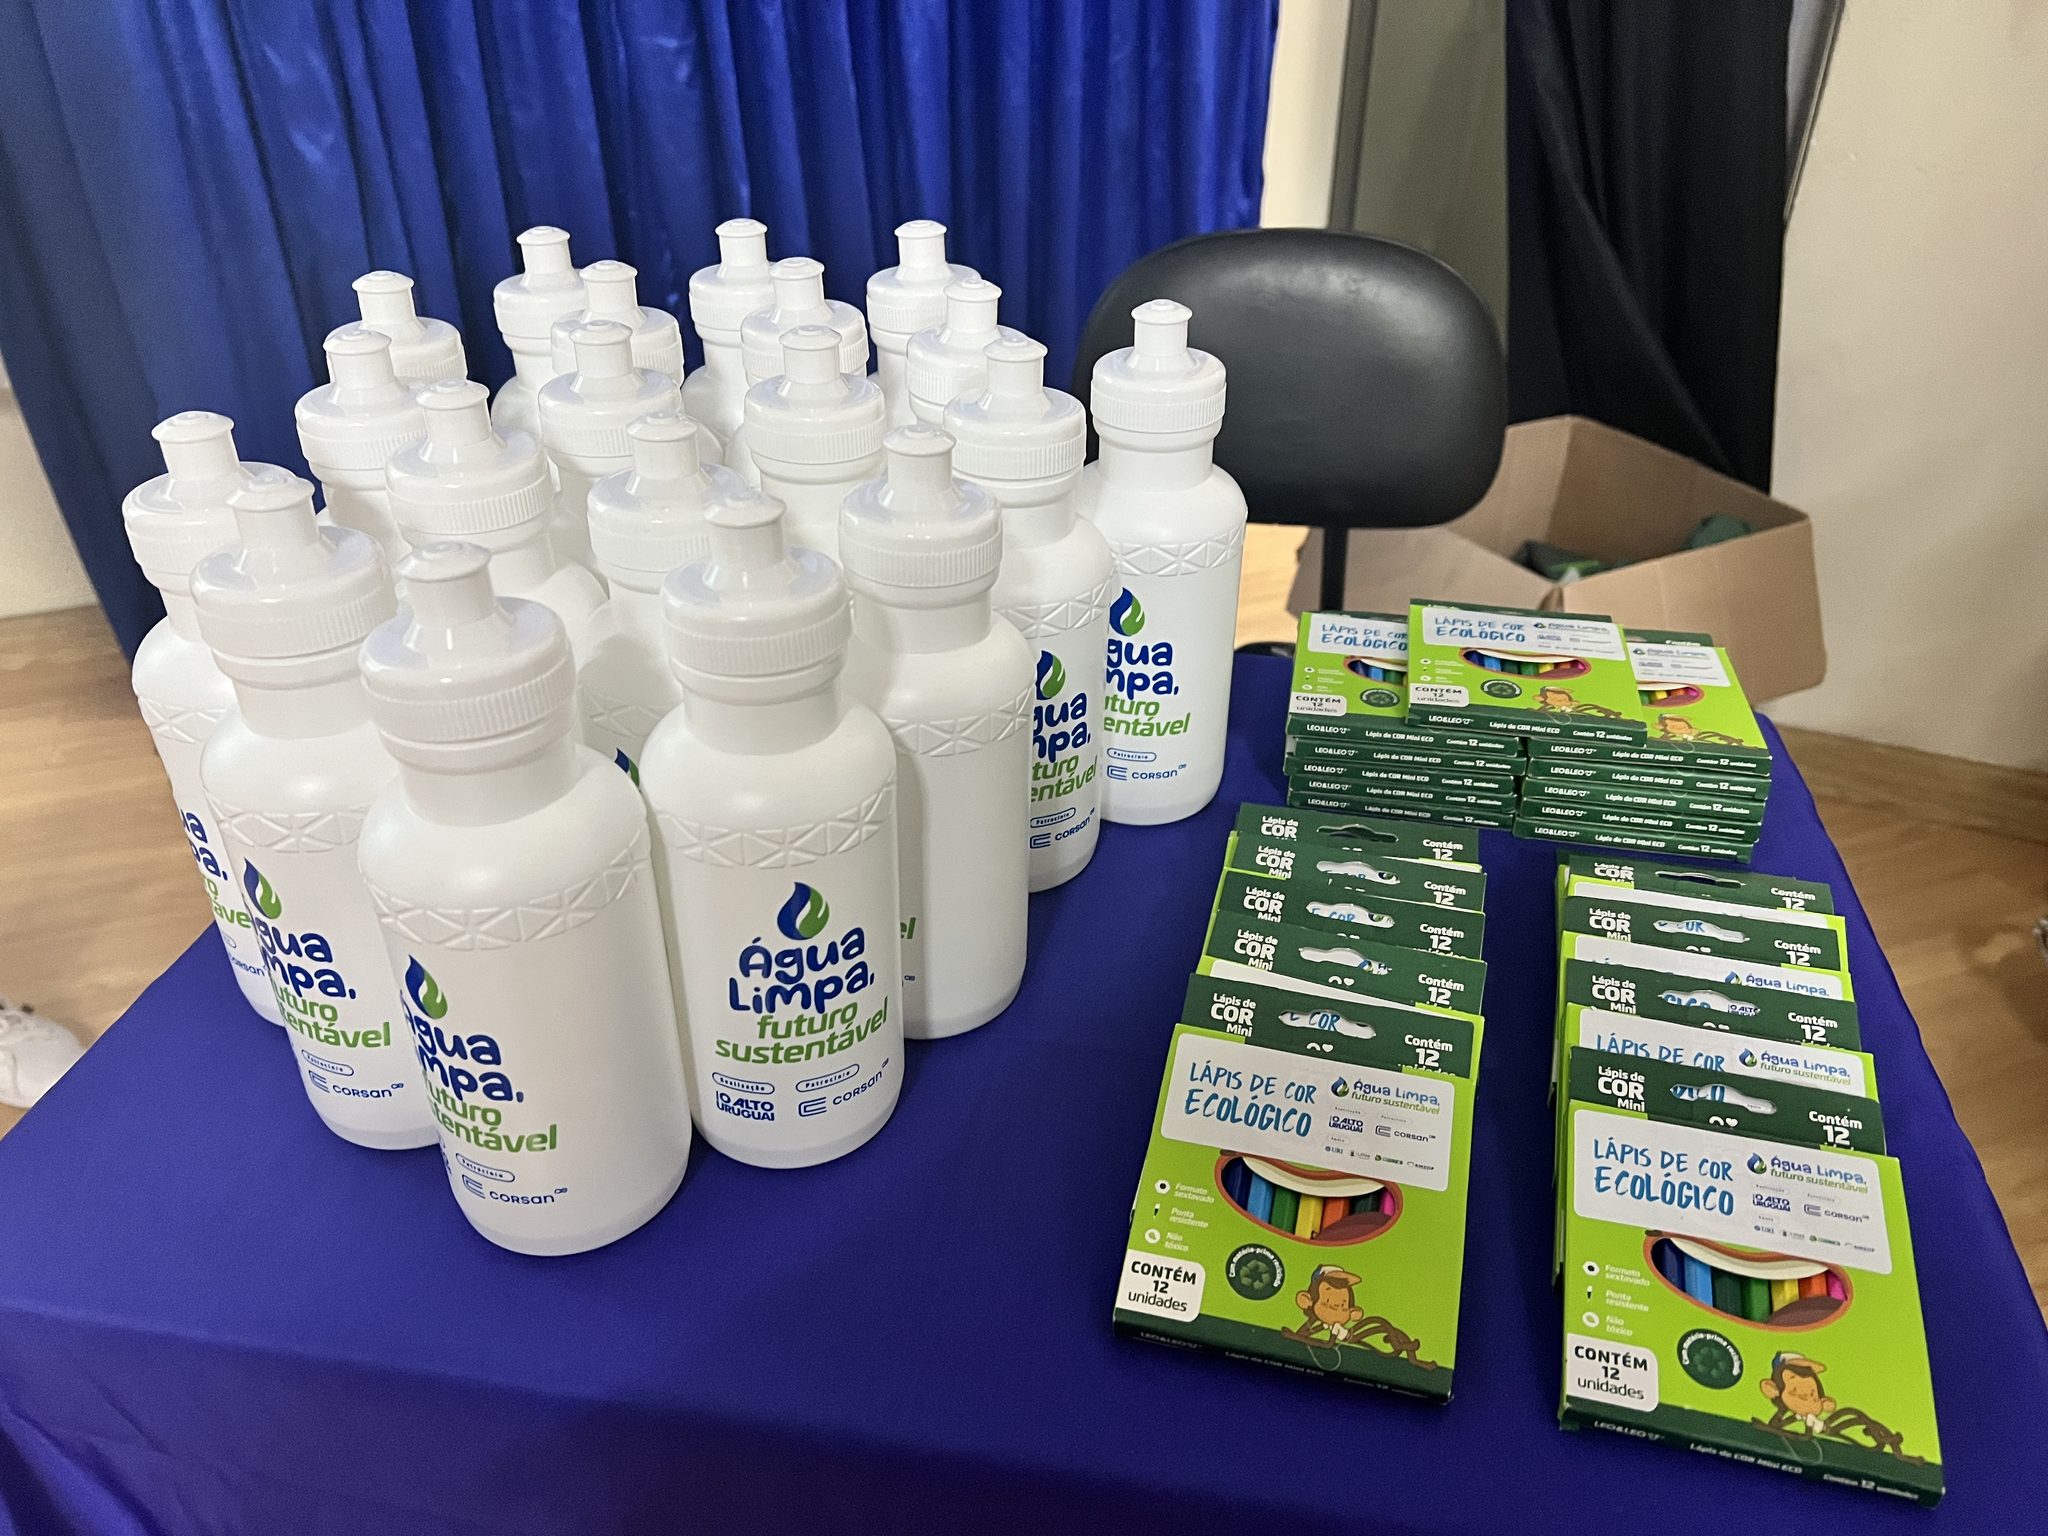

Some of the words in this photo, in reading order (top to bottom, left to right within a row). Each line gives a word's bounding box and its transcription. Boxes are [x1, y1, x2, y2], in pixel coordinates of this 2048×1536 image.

[1363, 628, 1381, 637] DE
[1478, 620, 1496, 629] DE
[1502, 622, 1525, 631] COR
[1321, 633, 1408, 651] ECOLÓGICO
[1436, 626, 1525, 643] ECOLÓGICO
[1107, 638, 1173, 668] gua
[1595, 731, 1606, 739] 12
[1262, 816, 1286, 826] Lápis
[1287, 819, 1299, 827] de
[1261, 823, 1297, 839] COR
[1258, 845, 1282, 856] Lápis
[1283, 850, 1296, 859] de
[1422, 839, 1463, 851] Contém
[1255, 852, 1294, 871] COR
[1432, 848, 1453, 861] 12
[1594, 867, 1634, 881] COR
[1246, 886, 1272, 898] Lápis
[1272, 891, 1286, 901] de
[1424, 881, 1466, 895] Contém
[1771, 887, 1816, 900] Contém
[1243, 895, 1283, 915] COR
[1433, 891, 1455, 906] 12
[1782, 896, 1805, 911] 12
[1589, 908, 1617, 918] Lápis
[1617, 912, 1631, 920] de
[1420, 923, 1465, 939] Contém
[1589, 915, 1630, 933] COR
[1237, 929, 1264, 942] Lápis
[1265, 936, 1279, 945] de
[1429, 935, 1452, 951] 12
[1234, 938, 1276, 960] COR
[1774, 939, 1821, 955] Contém
[739, 927, 865, 985] Água
[1786, 950, 1811, 967] 12
[1418, 974, 1465, 992] Contém
[1592, 975, 1620, 988] Lápis
[1622, 979, 1636, 990] de
[1745, 973, 1781, 988] Água
[1213, 993, 1242, 1006] Lápis
[1242, 999, 1257, 1009] de
[1428, 987, 1451, 1006] 12
[1591, 984, 1636, 1005] COR
[1210, 1003, 1254, 1026] COR
[1610, 1001, 1637, 1015] Mini
[757, 1002, 858, 1040] futuro
[1787, 1012, 1838, 1029] Contém
[715, 995, 888, 1064] sustentável
[1226, 1023, 1253, 1037] Mini
[1801, 1024, 1827, 1042] 12
[1404, 1034, 1453, 1052] Contém
[1415, 1048, 1440, 1068] 12
[1596, 1032, 1651, 1058] LÁPIS
[1658, 1045, 1685, 1065] DE
[1693, 1052, 1725, 1072] COR
[1760, 1051, 1799, 1068] Água
[1598, 1066, 1628, 1081] Lápis
[1630, 1071, 1645, 1083] de
[1760, 1062, 1791, 1074] futuro
[1189, 1060, 1243, 1091] LÁPIS
[1250, 1074, 1277, 1095] DE
[1284, 1081, 1317, 1105] COR
[1353, 1079, 1391, 1096] Água
[1597, 1076, 1645, 1101] COR
[716, 1100, 775, 1121] URUGUAI
[733, 1098, 775, 1112] ALTO
[1351, 1091, 1381, 1104] futuro
[1383, 1098, 1440, 1115] sustentável
[1617, 1098, 1645, 1112] Mini
[1184, 1088, 1312, 1137] ECOLÓGICO
[1808, 1110, 1863, 1130] Contém
[1822, 1124, 1851, 1146] 12
[1594, 1137, 1651, 1168] LÁPIS
[1660, 1151, 1688, 1173] DE
[1699, 1158, 1733, 1182] COR
[1770, 1155, 1812, 1174] Água
[1770, 1168, 1804, 1181] futuro
[1806, 1176, 1868, 1194] sustentável
[1594, 1166, 1734, 1216] ECOLÓGICO
[1171, 1207, 1194, 1219] Ponta
[1169, 1216, 1209, 1229] resistente
[1131, 1260, 1197, 1285] CONTÉM
[1152, 1280, 1169, 1294] 12
[1128, 1291, 1188, 1312] unidades
[1574, 1346, 1648, 1371] CONTÉM
[1602, 1366, 1620, 1380] 12
[1577, 1377, 1645, 1400] unidades
